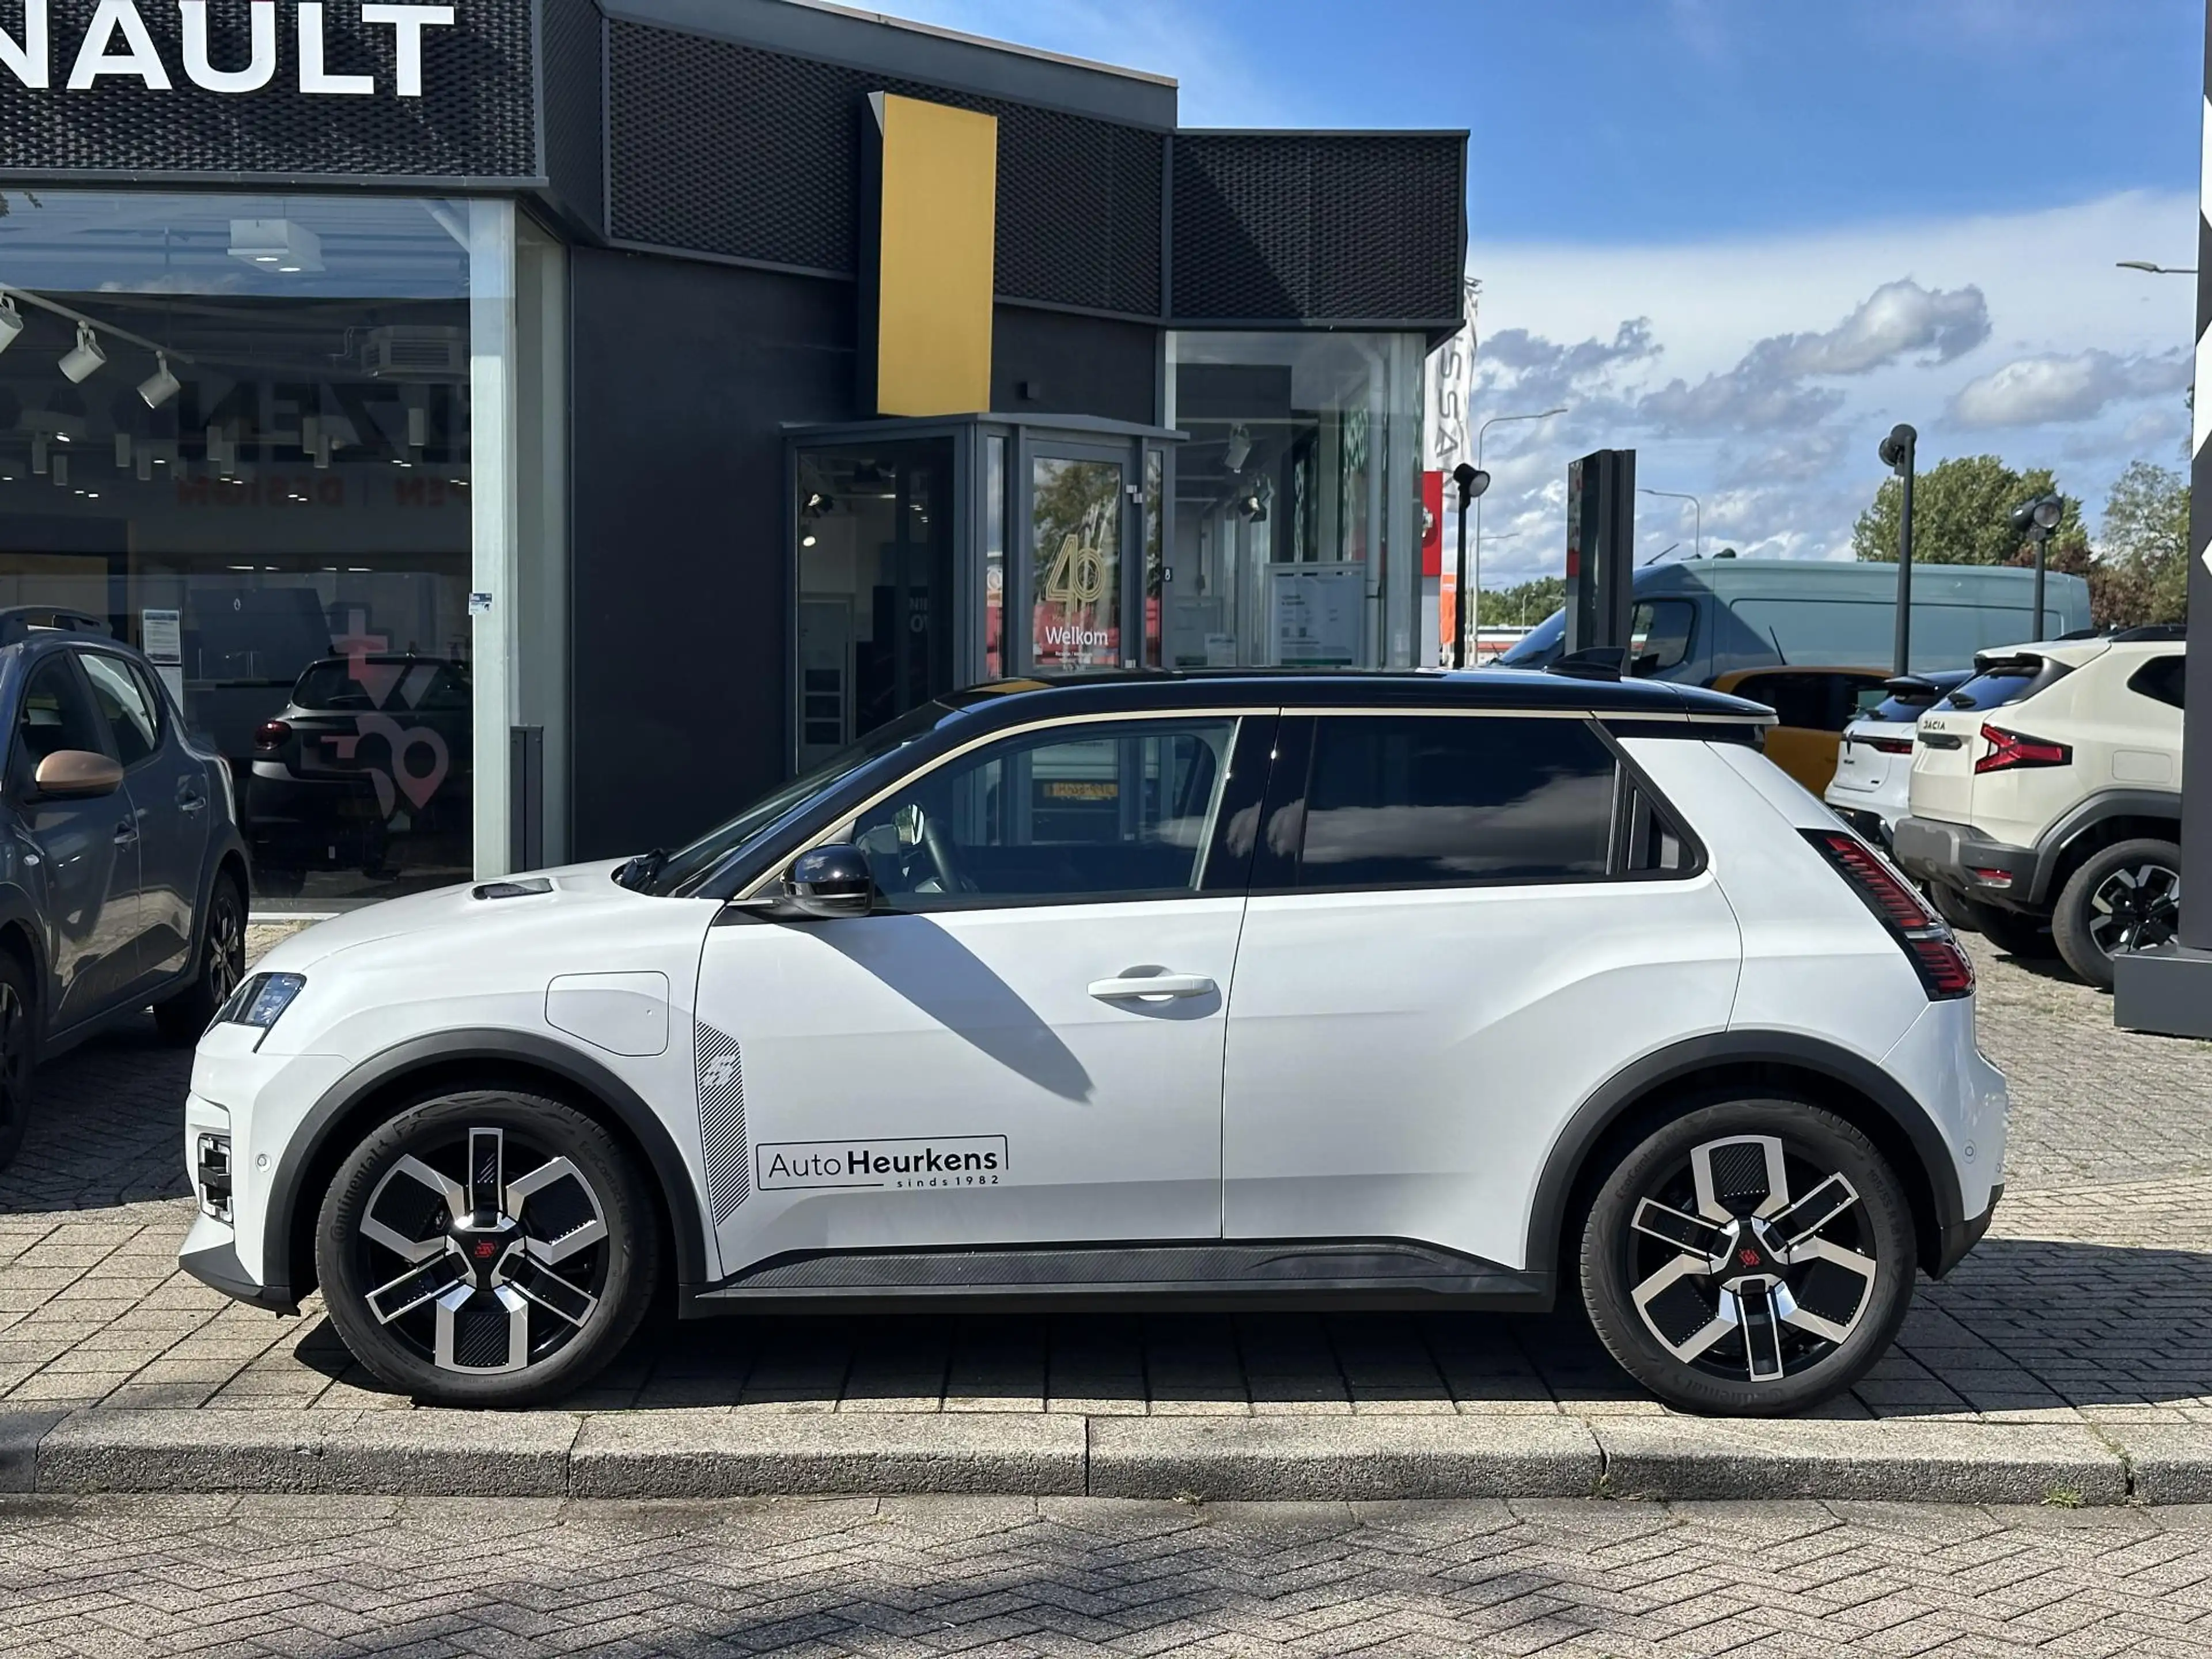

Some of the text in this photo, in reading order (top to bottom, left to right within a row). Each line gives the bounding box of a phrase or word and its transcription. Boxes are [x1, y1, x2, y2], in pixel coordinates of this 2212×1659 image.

[1165, 568, 1171, 581] 8
[1045, 626, 1109, 646] Welkom
[1923, 721, 1945, 730] DACIA
[897, 1175, 999, 1188] sinds 1982
[331, 1147, 382, 1243] Continental
